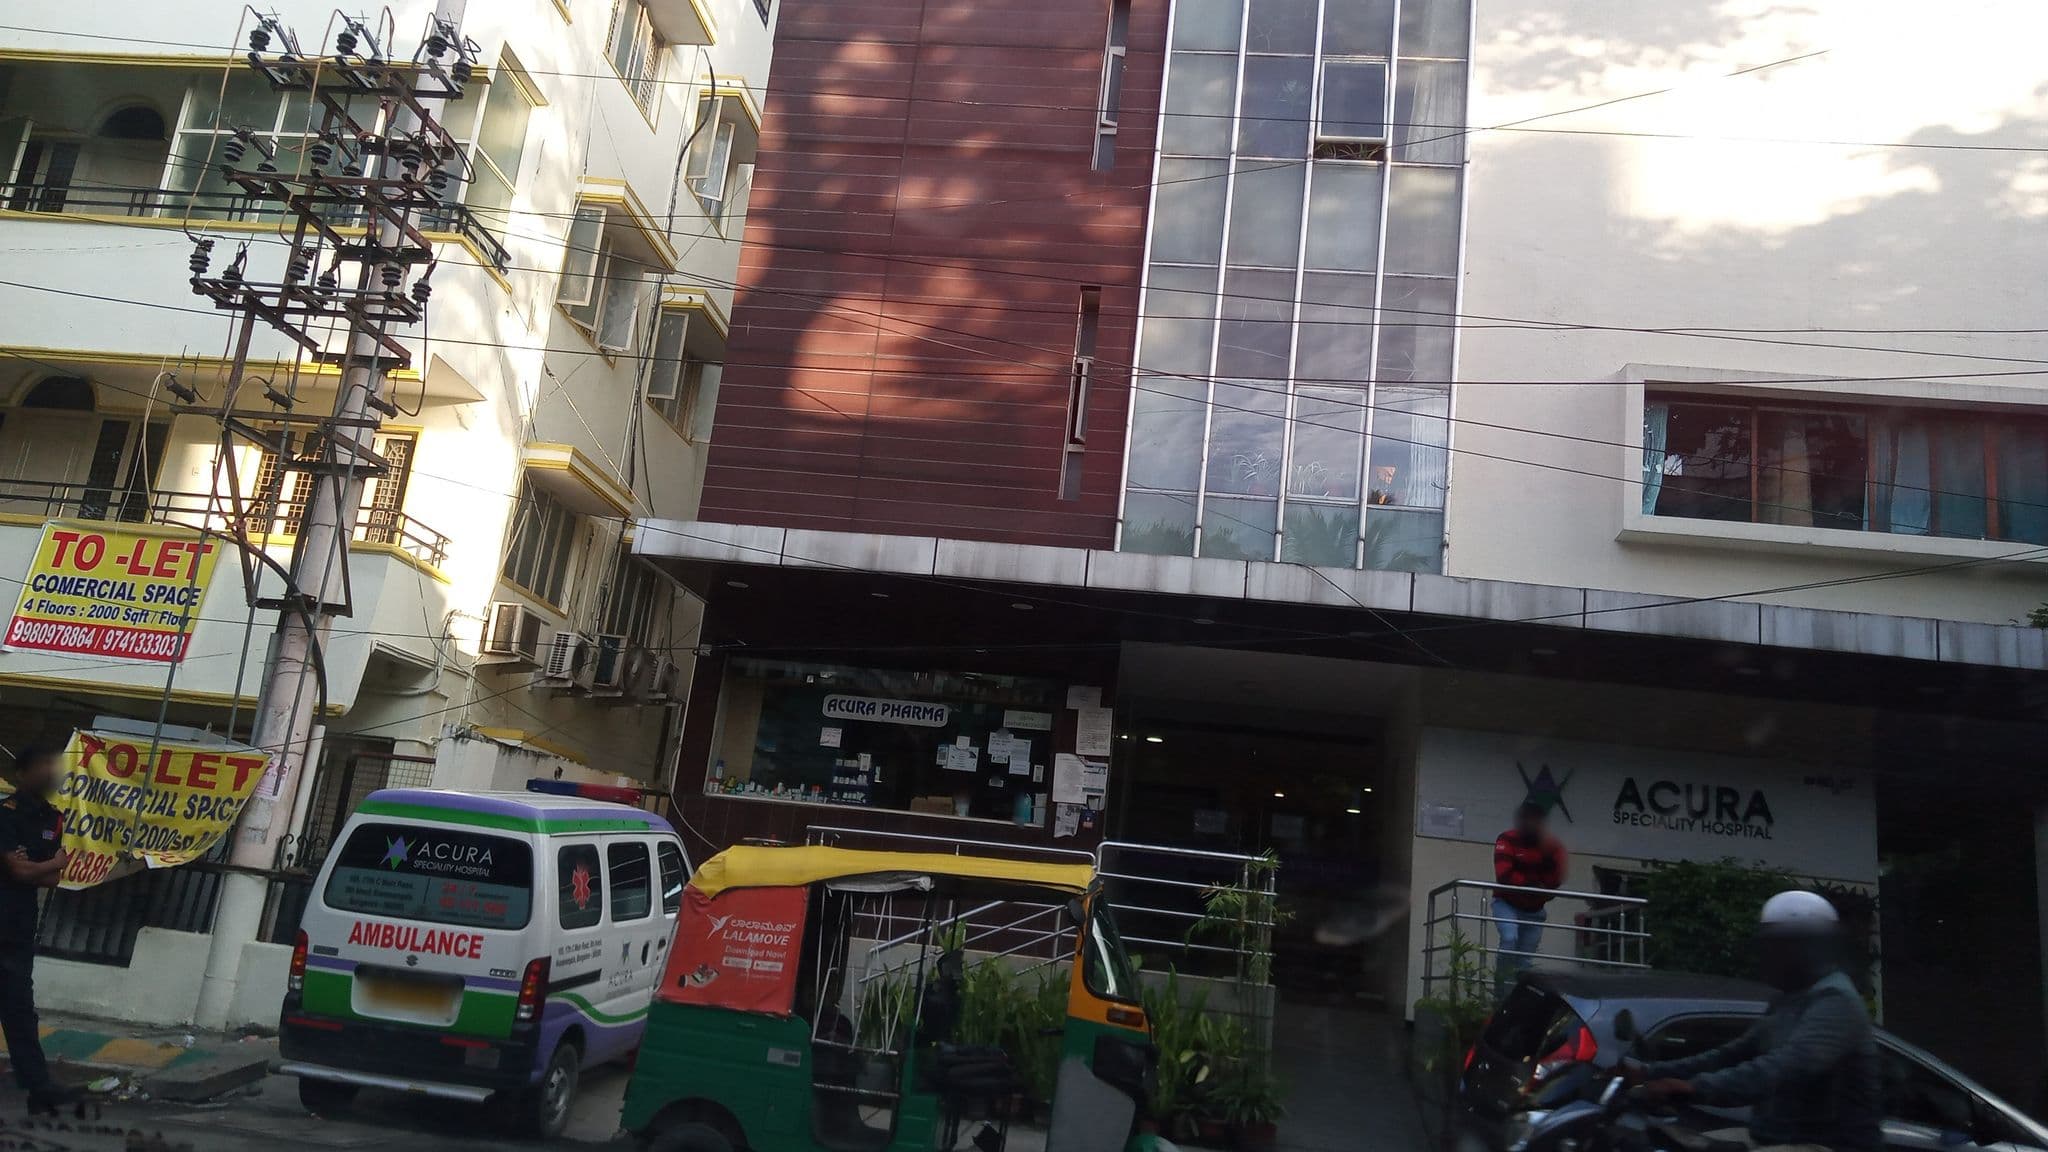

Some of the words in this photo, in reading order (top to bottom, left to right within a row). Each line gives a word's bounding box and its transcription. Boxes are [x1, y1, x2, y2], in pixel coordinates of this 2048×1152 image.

[51, 531, 105, 571] TO
[32, 573, 136, 601] COMERCIAL
[143, 582, 201, 606] SPACE
[24, 599, 33, 611] 4
[36, 599, 76, 616] Floors
[87, 604, 120, 620] 2000
[122, 607, 151, 625] Sqft
[12, 620, 95, 648] 9980978864
[827, 698, 876, 715] ACURA
[880, 702, 945, 722] PHARMA
[78, 734, 264, 791] TO-LET
[57, 772, 176, 817] COMMERCIAL
[1614, 776, 1774, 824] ACURA
[1613, 810, 1697, 832] SPECIALITY
[1701, 820, 1772, 840] HOSPITAL
[418, 841, 493, 865] ACURA
[413, 860, 454, 874] SPECIALITY
[455, 863, 490, 878] HOSPITAL
[348, 921, 484, 959] AMBULANCE
[722, 929, 790, 946] LALAMOVE
[725, 945, 764, 957] Download
